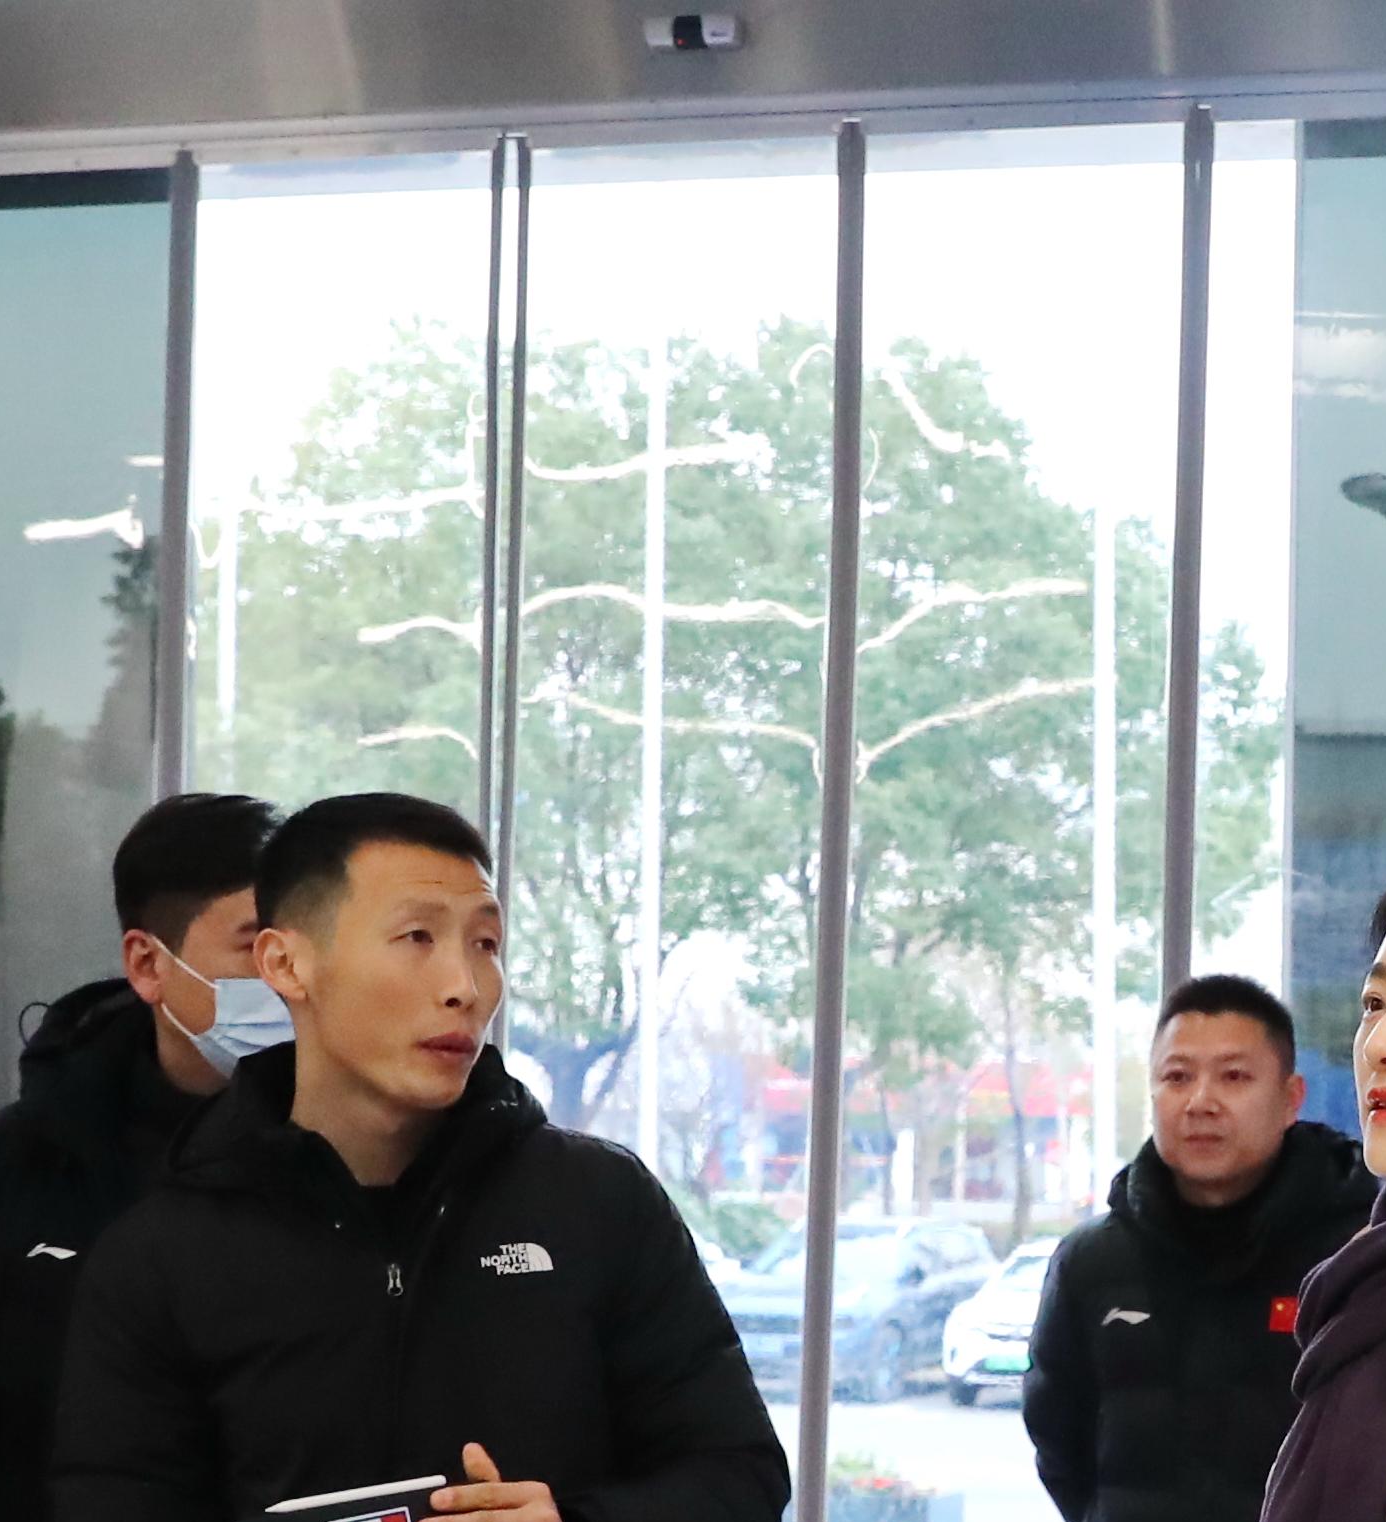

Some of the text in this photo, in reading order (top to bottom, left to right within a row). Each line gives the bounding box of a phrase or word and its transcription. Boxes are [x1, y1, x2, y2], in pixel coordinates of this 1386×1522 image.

[499, 1243, 526, 1256] THE
[480, 1252, 528, 1268] NORTH
[495, 1262, 530, 1276] FACE
